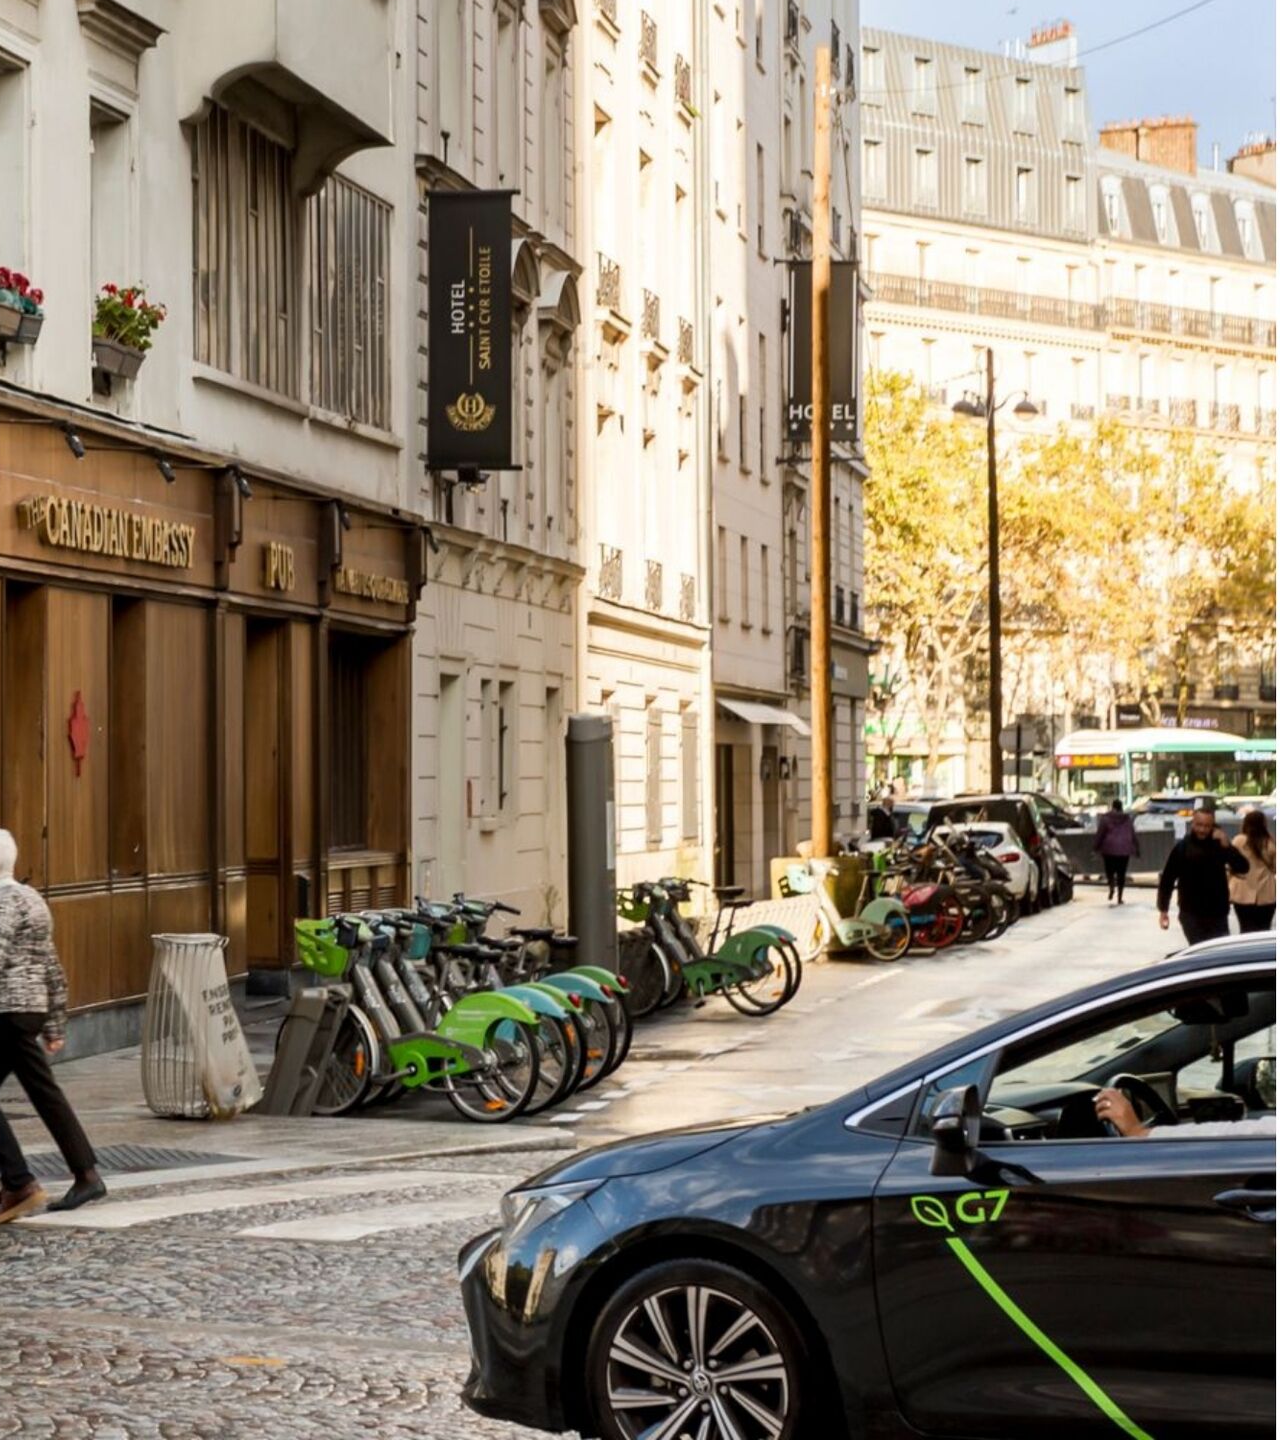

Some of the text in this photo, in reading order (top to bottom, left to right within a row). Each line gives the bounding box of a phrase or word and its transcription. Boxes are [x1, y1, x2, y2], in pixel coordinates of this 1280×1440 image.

[451, 279, 465, 334] HOTEL
[479, 245, 491, 370] SAINT CYR ETOILE
[789, 404, 855, 420] HOEL
[20, 495, 196, 570] THE CANADIAN EMBASSY
[270, 541, 296, 592] PUB
[956, 1189, 1009, 1223] G7
